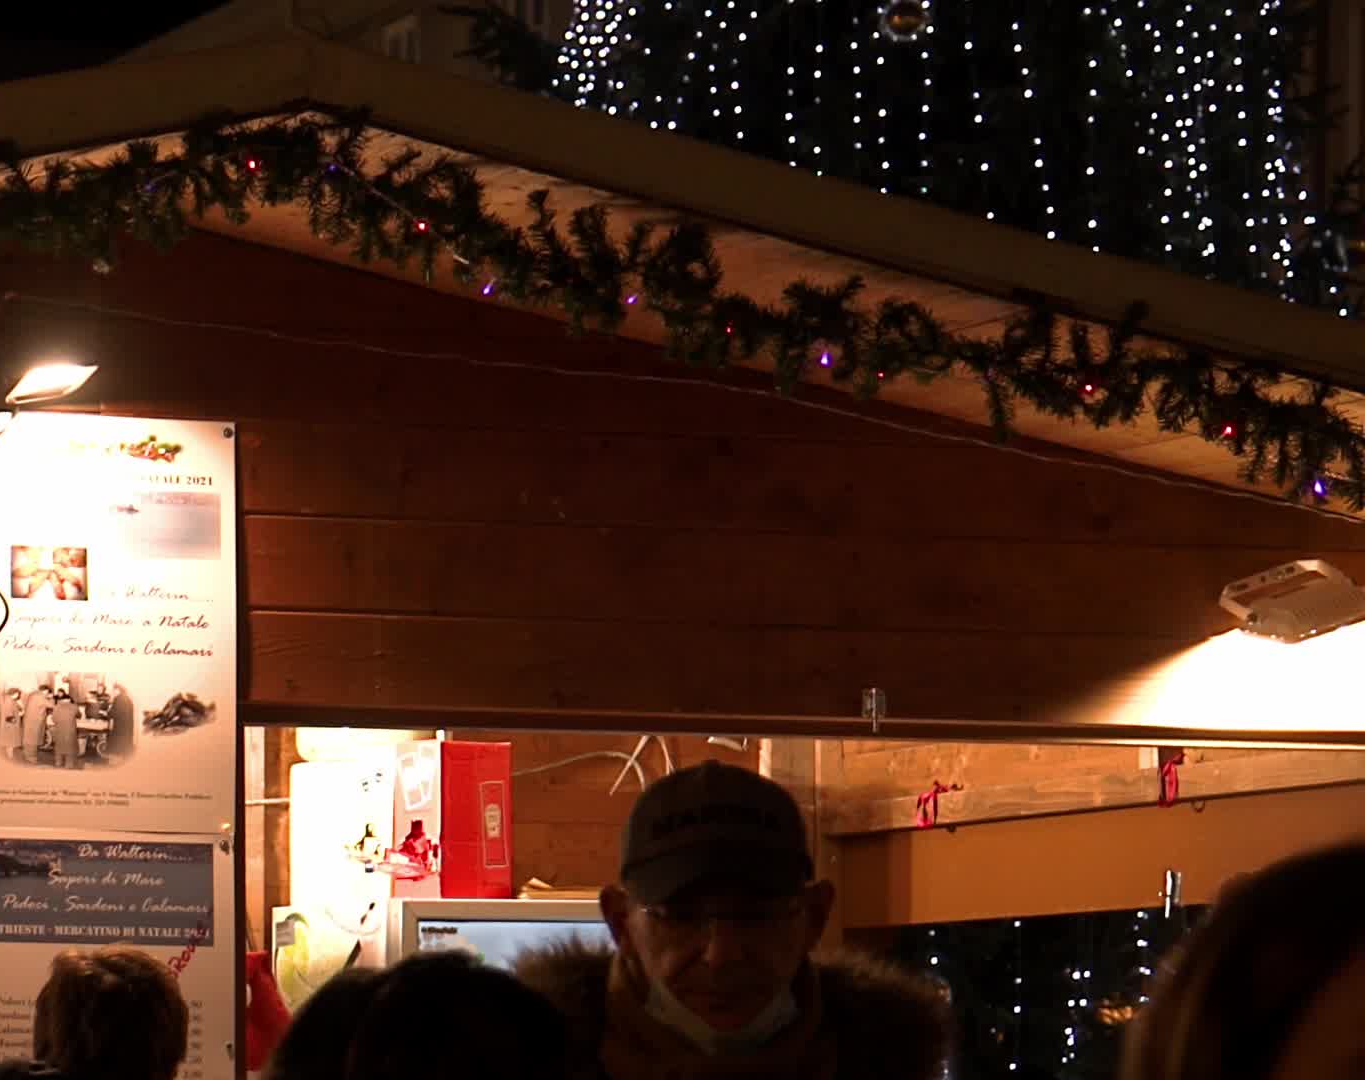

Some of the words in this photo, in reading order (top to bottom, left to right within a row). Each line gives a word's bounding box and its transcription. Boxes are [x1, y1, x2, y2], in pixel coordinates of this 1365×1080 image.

[186, 475, 213, 487] 2021
[158, 613, 212, 630] Natale
[63, 636, 126, 654] Sardoni
[143, 638, 214, 657] Calamari
[77, 843, 100, 858] Da
[47, 868, 97, 888] Sapori
[101, 871, 117, 885] di
[124, 873, 166, 886] Mare
[1, 892, 49, 910] Pedoci
[65, 895, 126, 913] Sardoni
[141, 897, 209, 914] Calamari
[54, 925, 122, 938] MERCATINO
[123, 926, 136, 938] DI
[138, 926, 181, 939] NATALE
